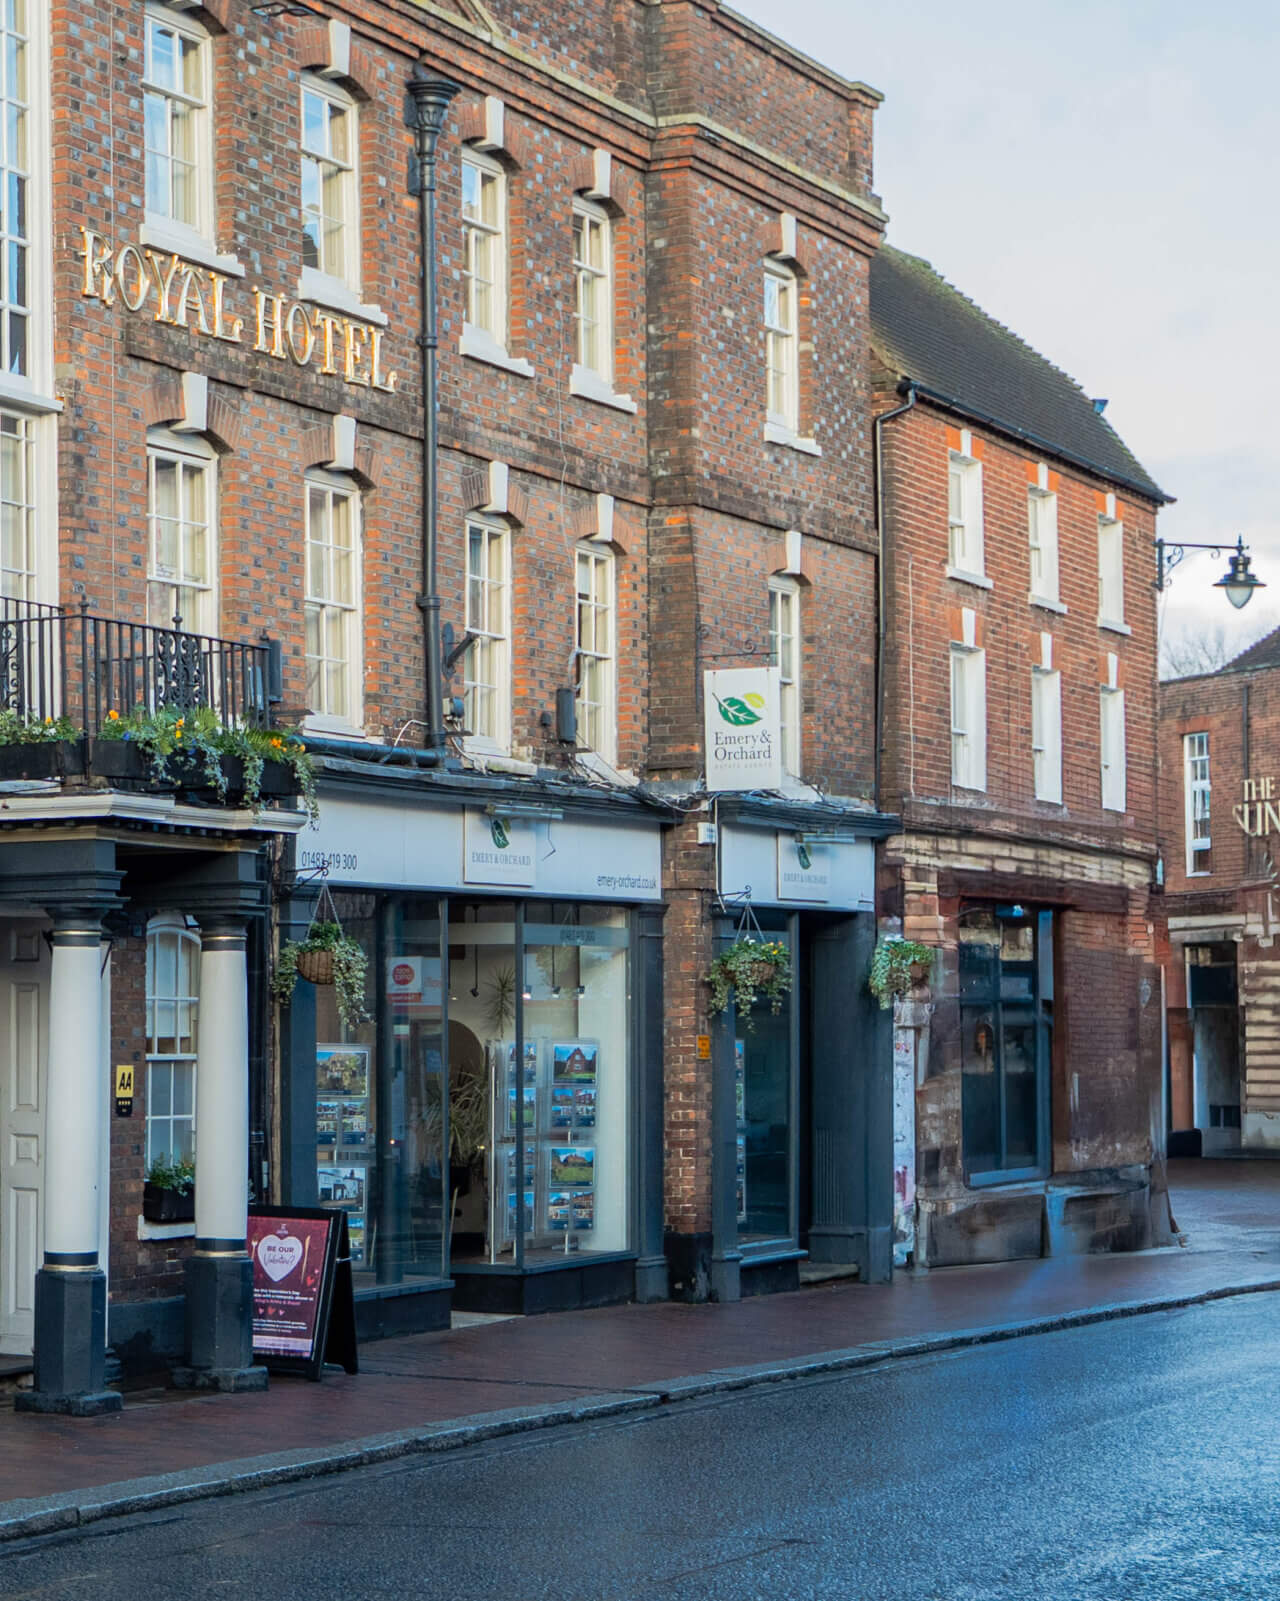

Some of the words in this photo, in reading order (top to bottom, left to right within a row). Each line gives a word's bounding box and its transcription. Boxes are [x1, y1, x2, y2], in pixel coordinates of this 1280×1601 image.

[79, 225, 244, 343] ROYAL
[252, 285, 398, 394] HOTEL
[714, 731, 759, 749] Emery
[714, 744, 772, 761] Orchard
[1241, 777, 1276, 801] THE
[328, 853, 341, 869] 419
[343, 854, 358, 871] 300
[118, 1072, 132, 1090] AA
